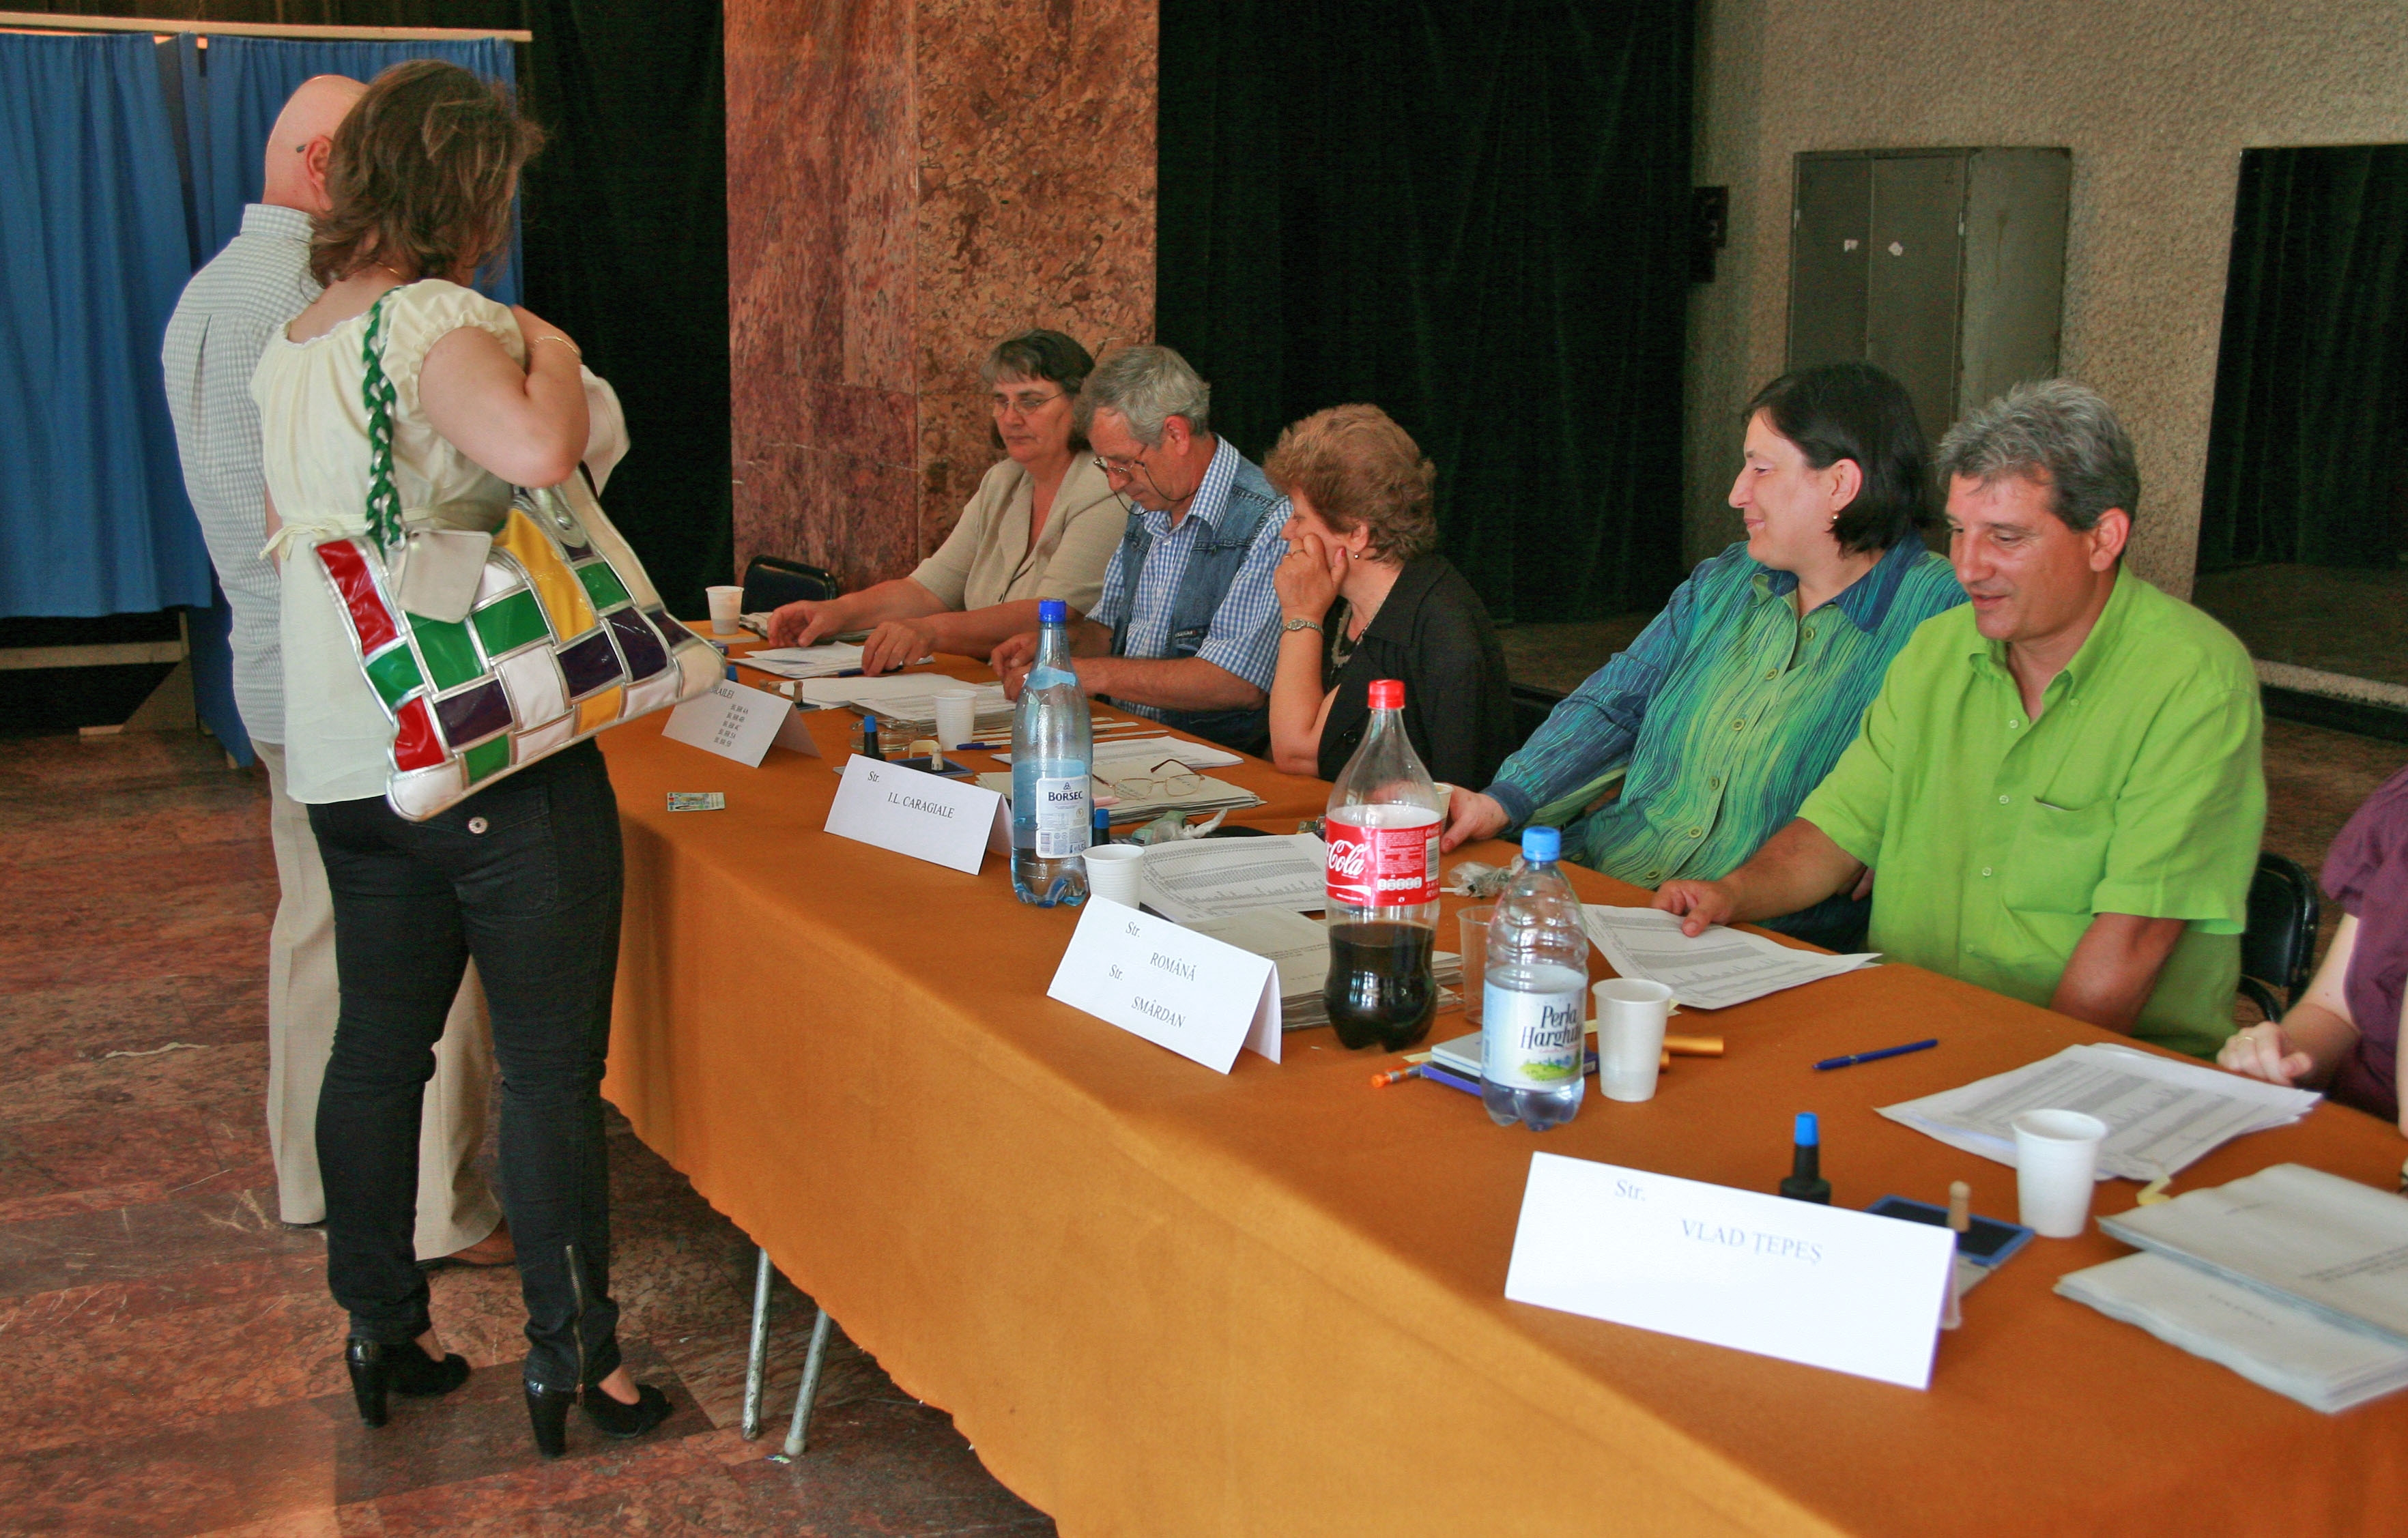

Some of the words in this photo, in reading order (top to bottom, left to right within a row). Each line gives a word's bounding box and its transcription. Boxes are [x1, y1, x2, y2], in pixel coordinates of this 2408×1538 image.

[868, 770, 880, 783] Str.
[888, 792, 900, 804] I.L.
[902, 796, 955, 819] CARAGIALE
[1126, 921, 1141, 938] Str.
[1109, 964, 1124, 981] Str.
[1131, 996, 1186, 1029] SMÂRDAN
[1540, 1003, 1577, 1028] Perla
[1613, 1179, 1647, 1203] Str.
[1681, 1219, 1745, 1249] VLAD
